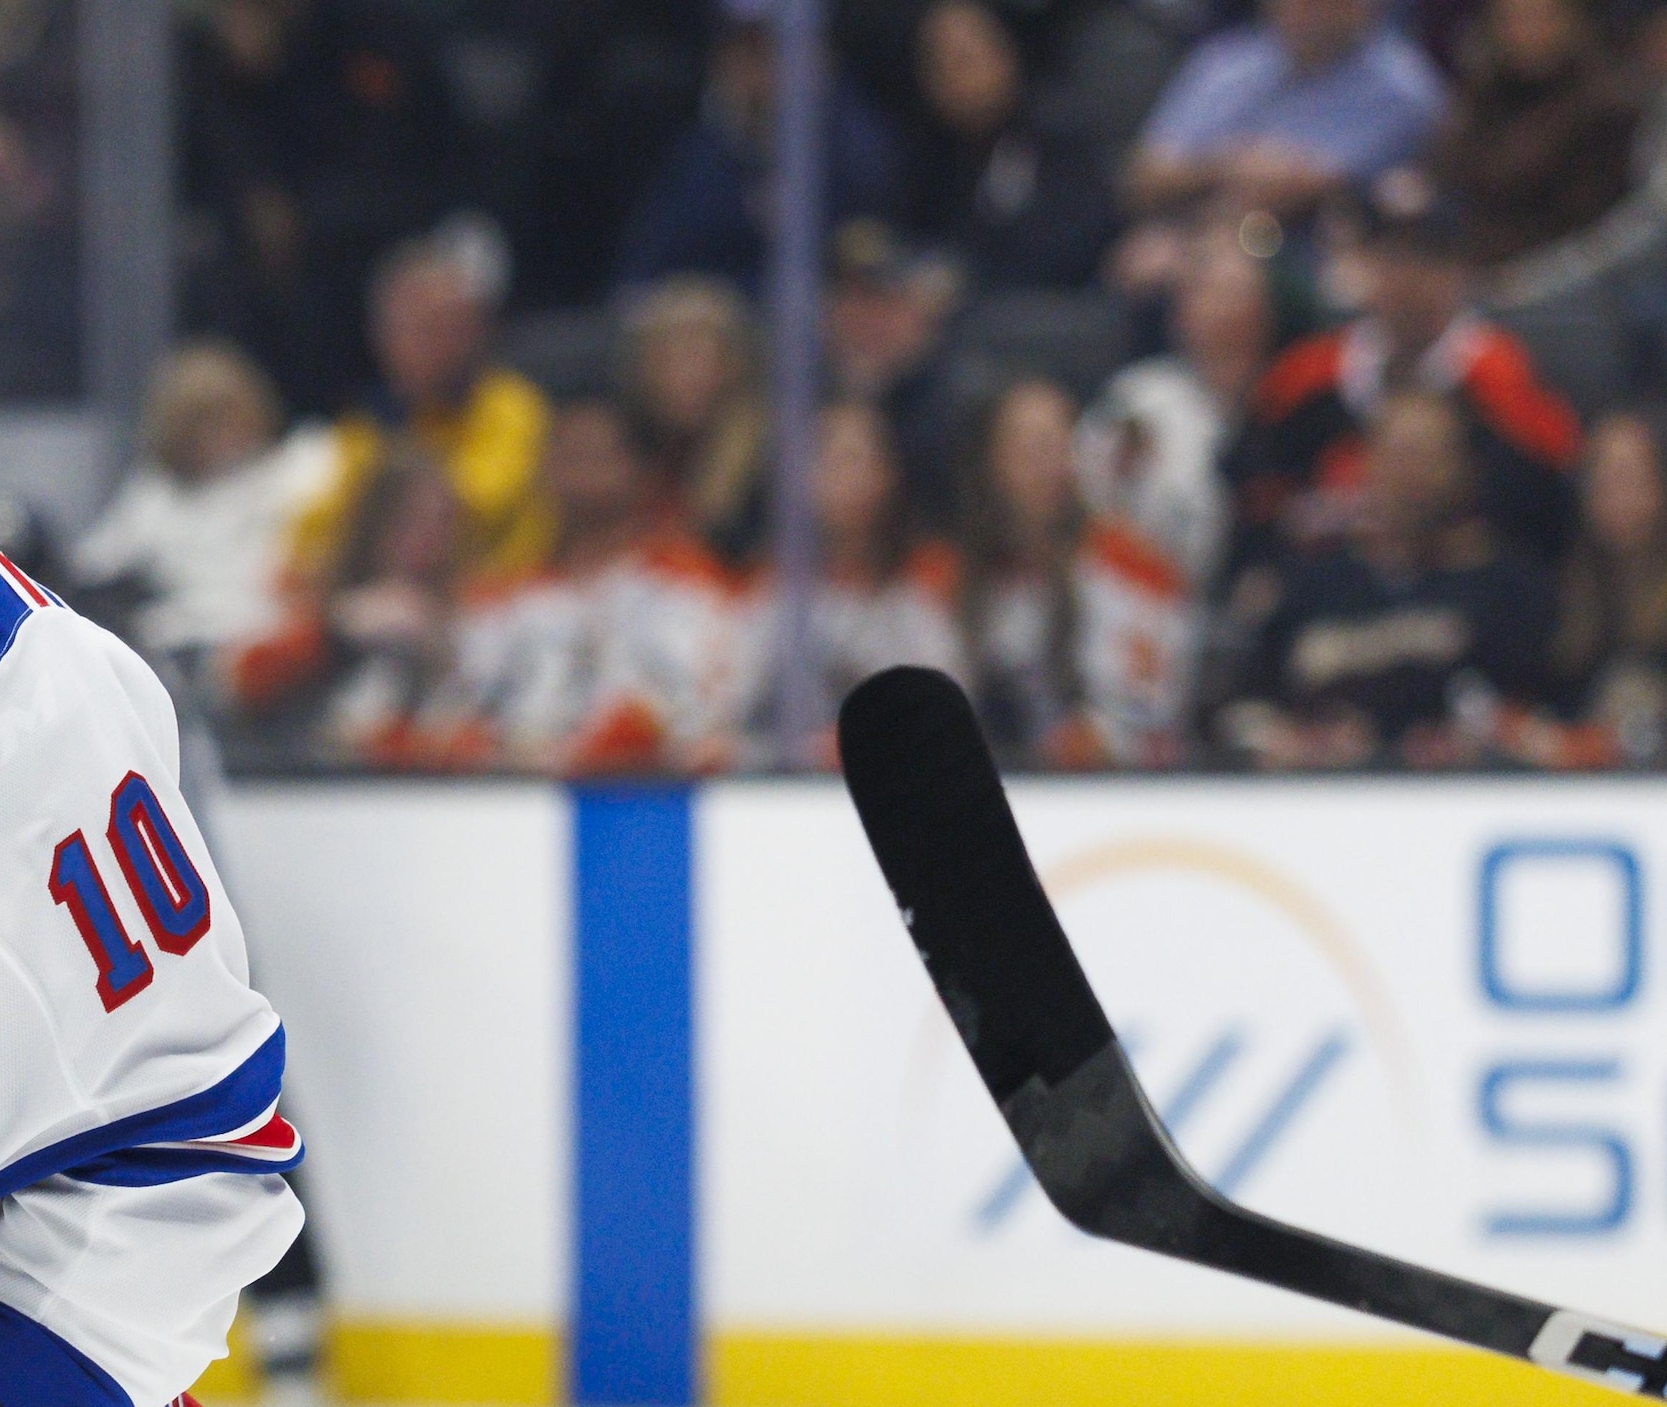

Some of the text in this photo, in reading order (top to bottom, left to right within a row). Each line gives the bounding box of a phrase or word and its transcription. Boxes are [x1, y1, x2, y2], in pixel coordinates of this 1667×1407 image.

[47, 770, 211, 1014] 10
[1479, 1052, 1667, 1240] S
[1529, 1308, 1667, 1400] C
